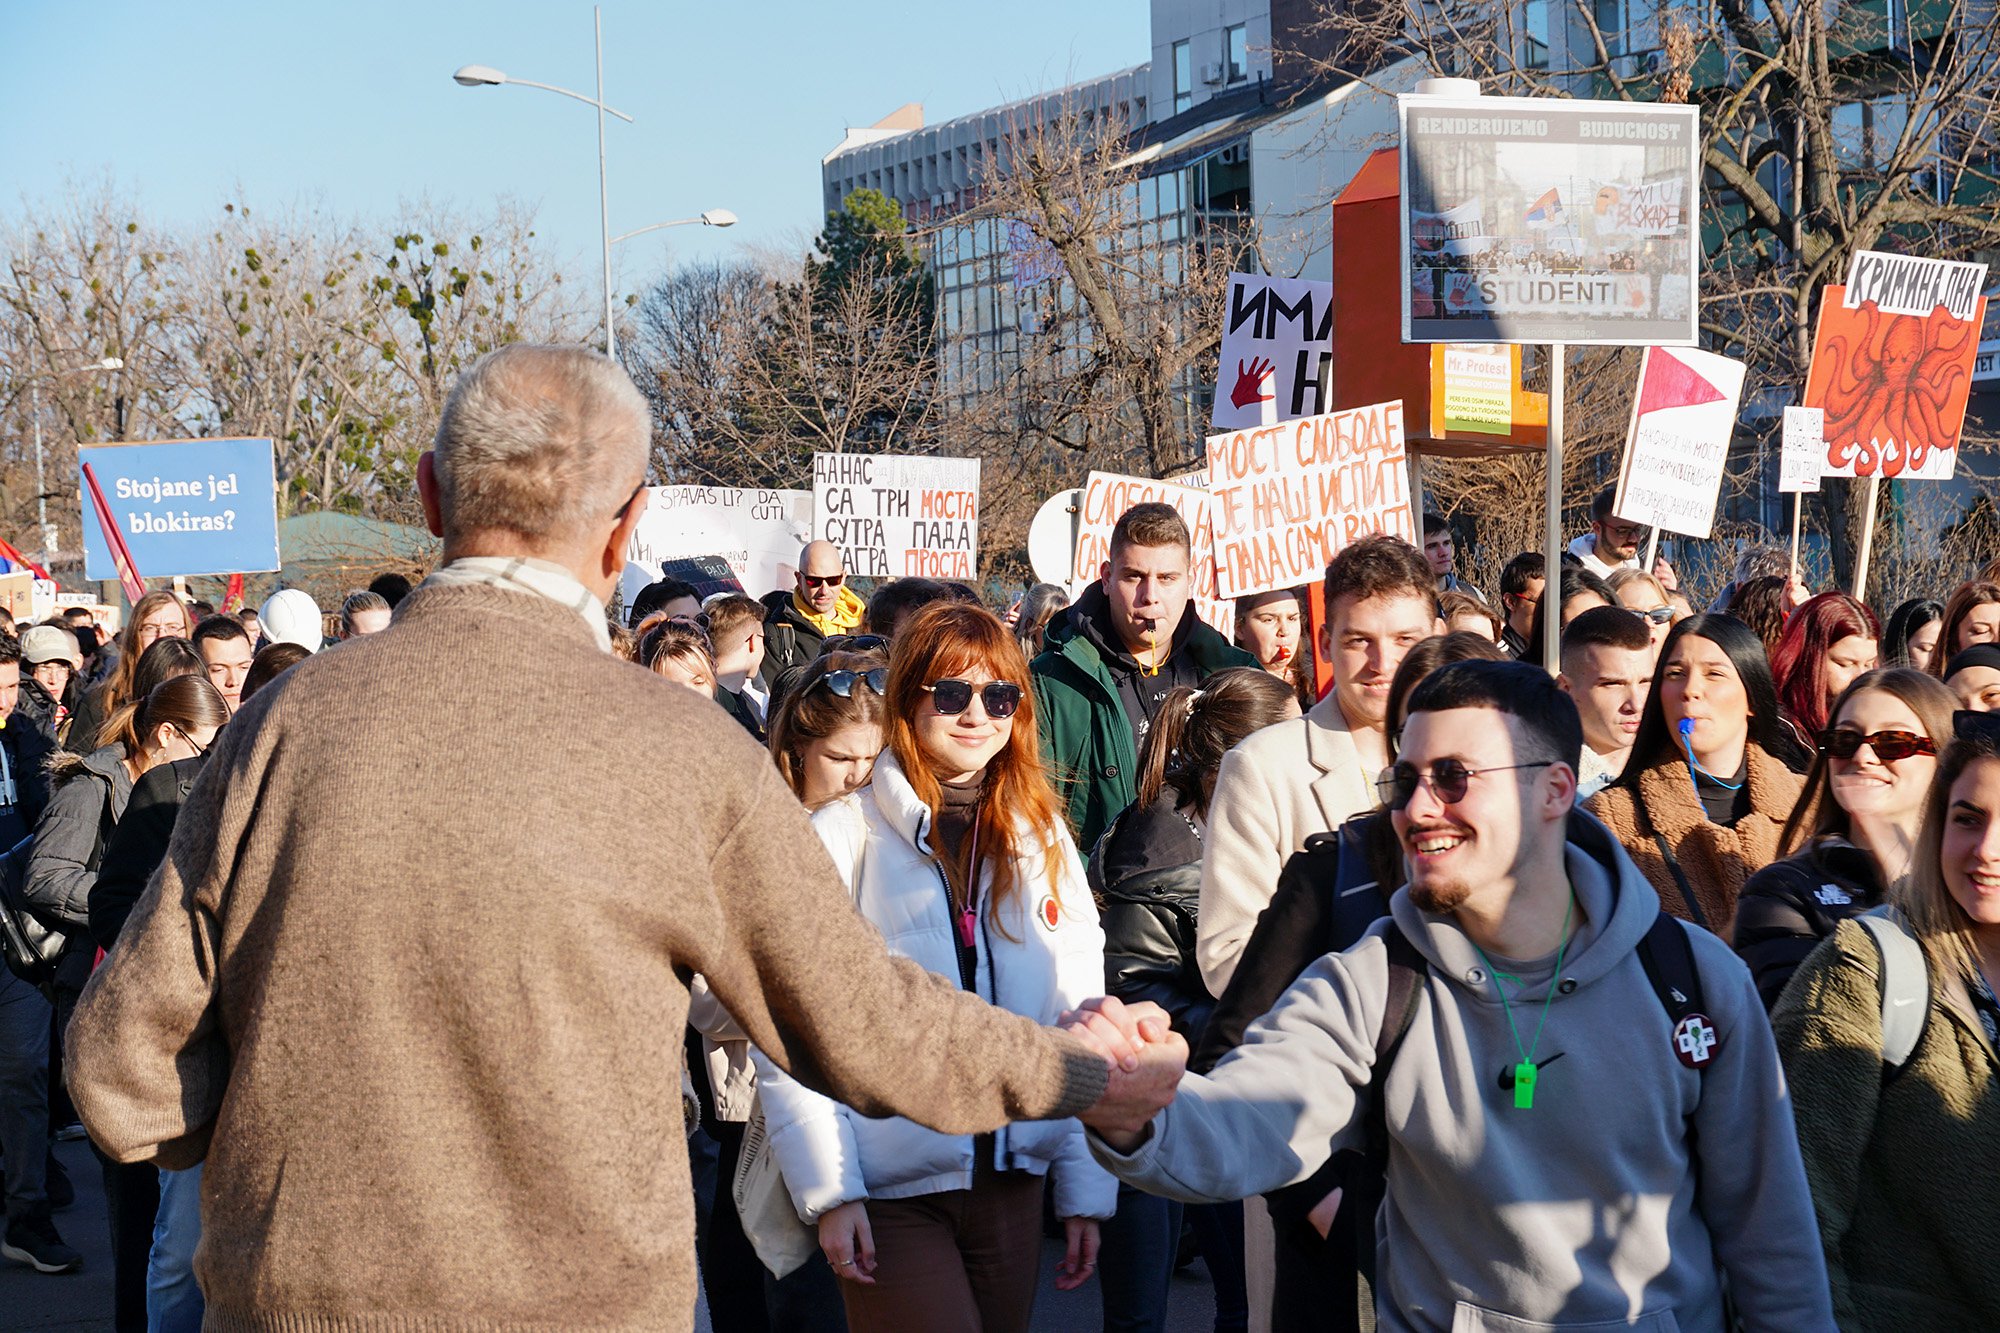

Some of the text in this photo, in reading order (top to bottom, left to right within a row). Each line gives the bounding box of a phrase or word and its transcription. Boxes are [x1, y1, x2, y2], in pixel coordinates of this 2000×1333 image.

[1481, 280, 1617, 305] STUDENTI
[1519, 327, 1567, 339] Rendering
[1448, 356, 1507, 375] Mr. Protest
[1207, 404, 1403, 483] МОСТ СЛОБОДЕ
[815, 455, 873, 485] ДАНАС
[116, 473, 239, 503] Stojane jel
[660, 485, 717, 510] SPAVAŠ
[722, 489, 743, 508] LI?
[1214, 455, 1405, 541] ЈЕ НАШ ИСПИТ
[825, 487, 975, 520] СА ТРИ МОСТА
[128, 510, 236, 534] blokiras?
[825, 517, 971, 550] СУТРА ПАДА
[836, 546, 970, 578] АГРА ПРОСТА
[1285, 518, 1339, 578] САМО
